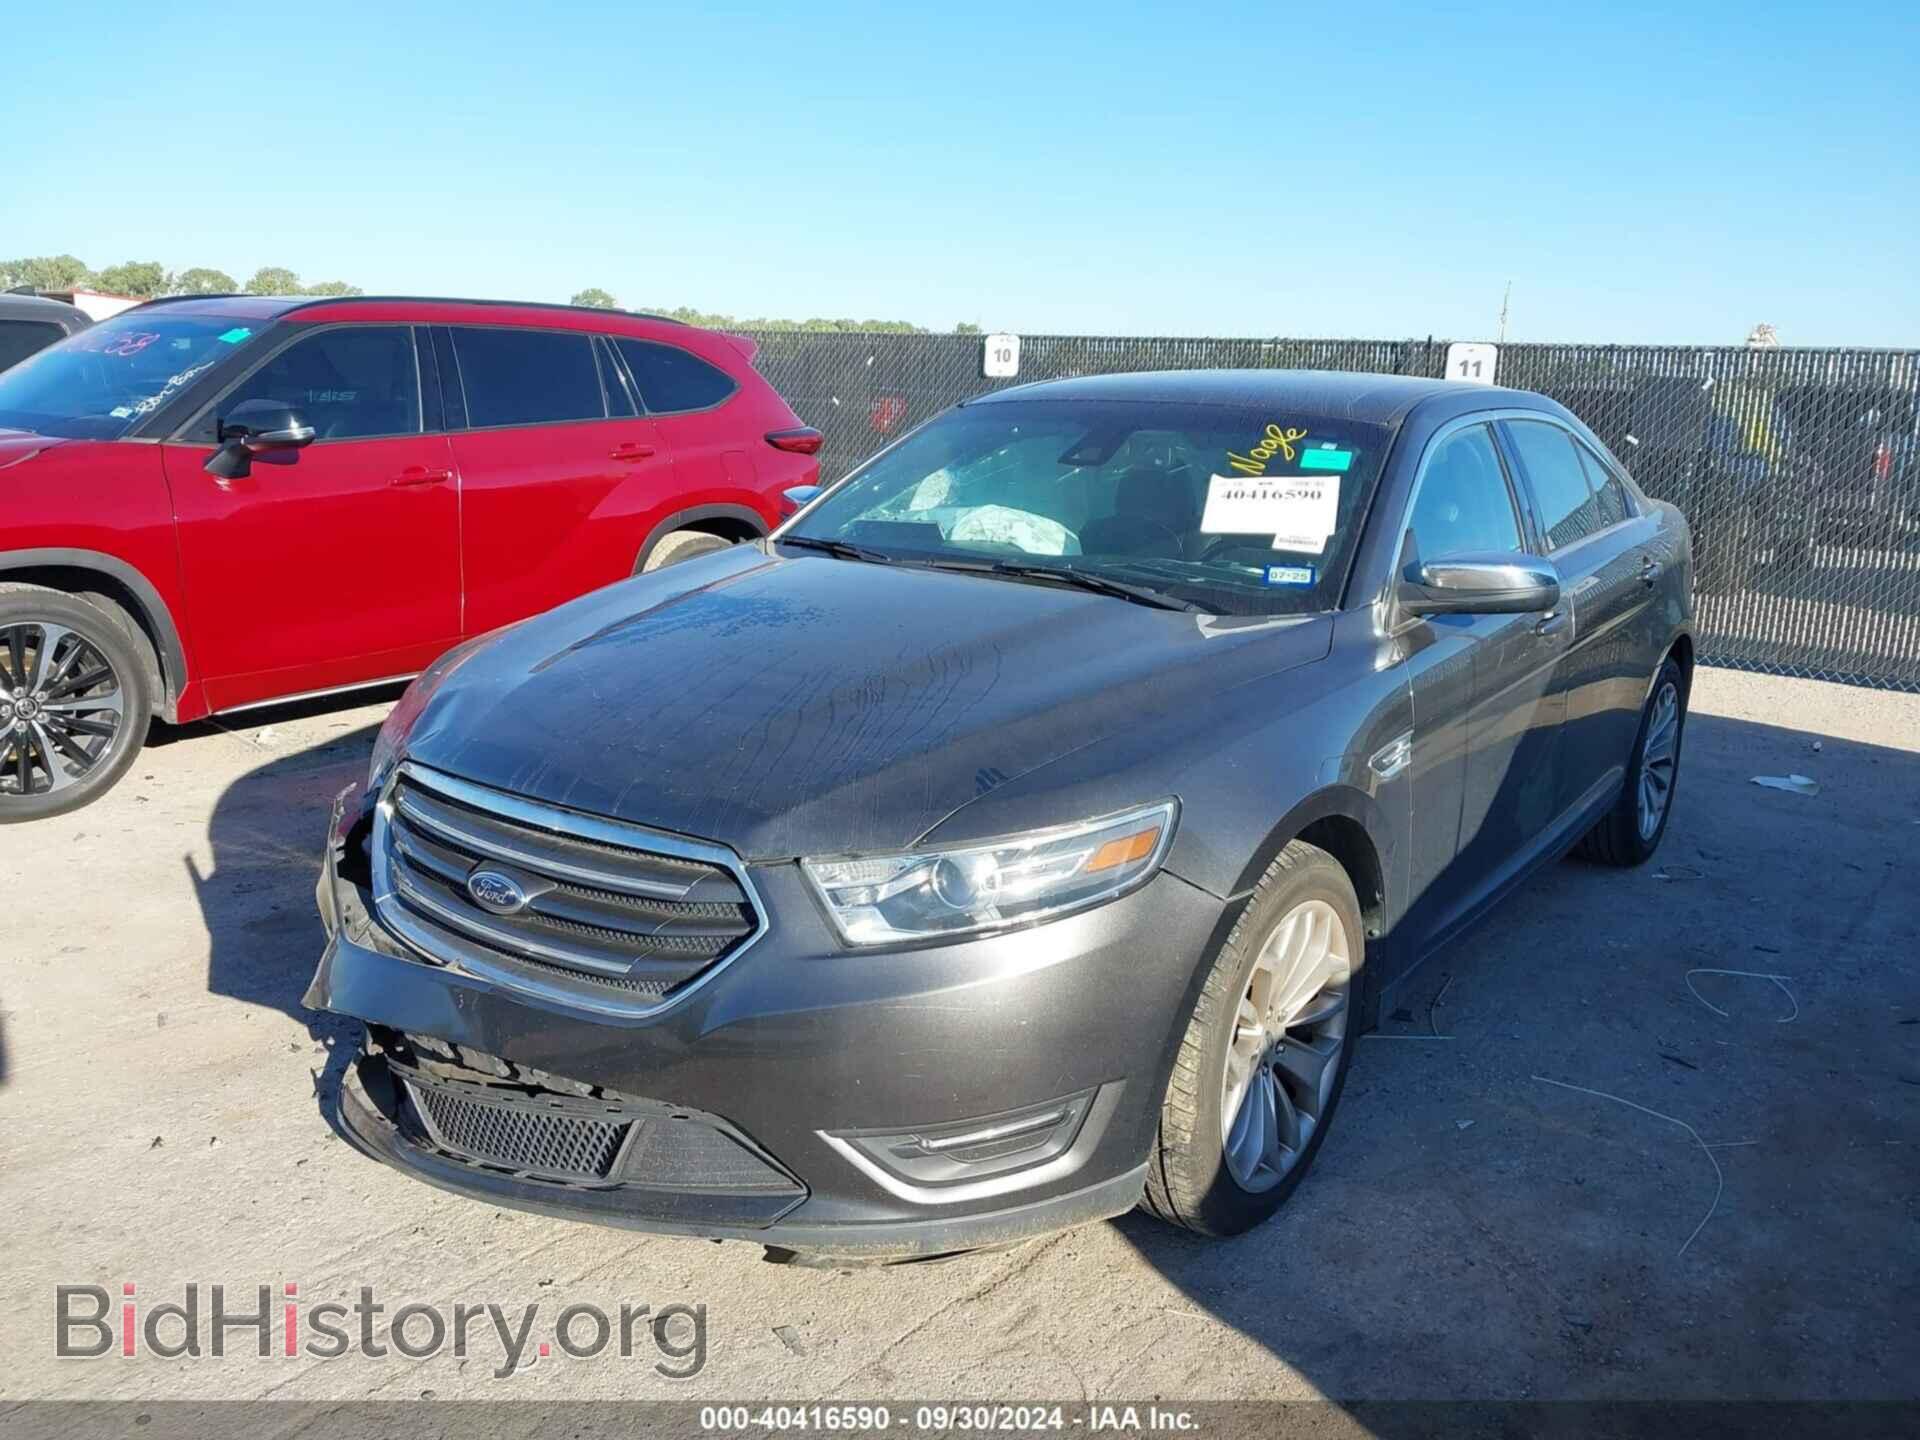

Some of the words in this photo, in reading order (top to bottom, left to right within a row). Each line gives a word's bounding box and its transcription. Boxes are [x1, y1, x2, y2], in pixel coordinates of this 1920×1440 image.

[994, 349, 1011, 362] 10
[1459, 360, 1482, 377] 11
[1221, 489, 1323, 500] 40416590
[476, 879, 515, 905] Ford
